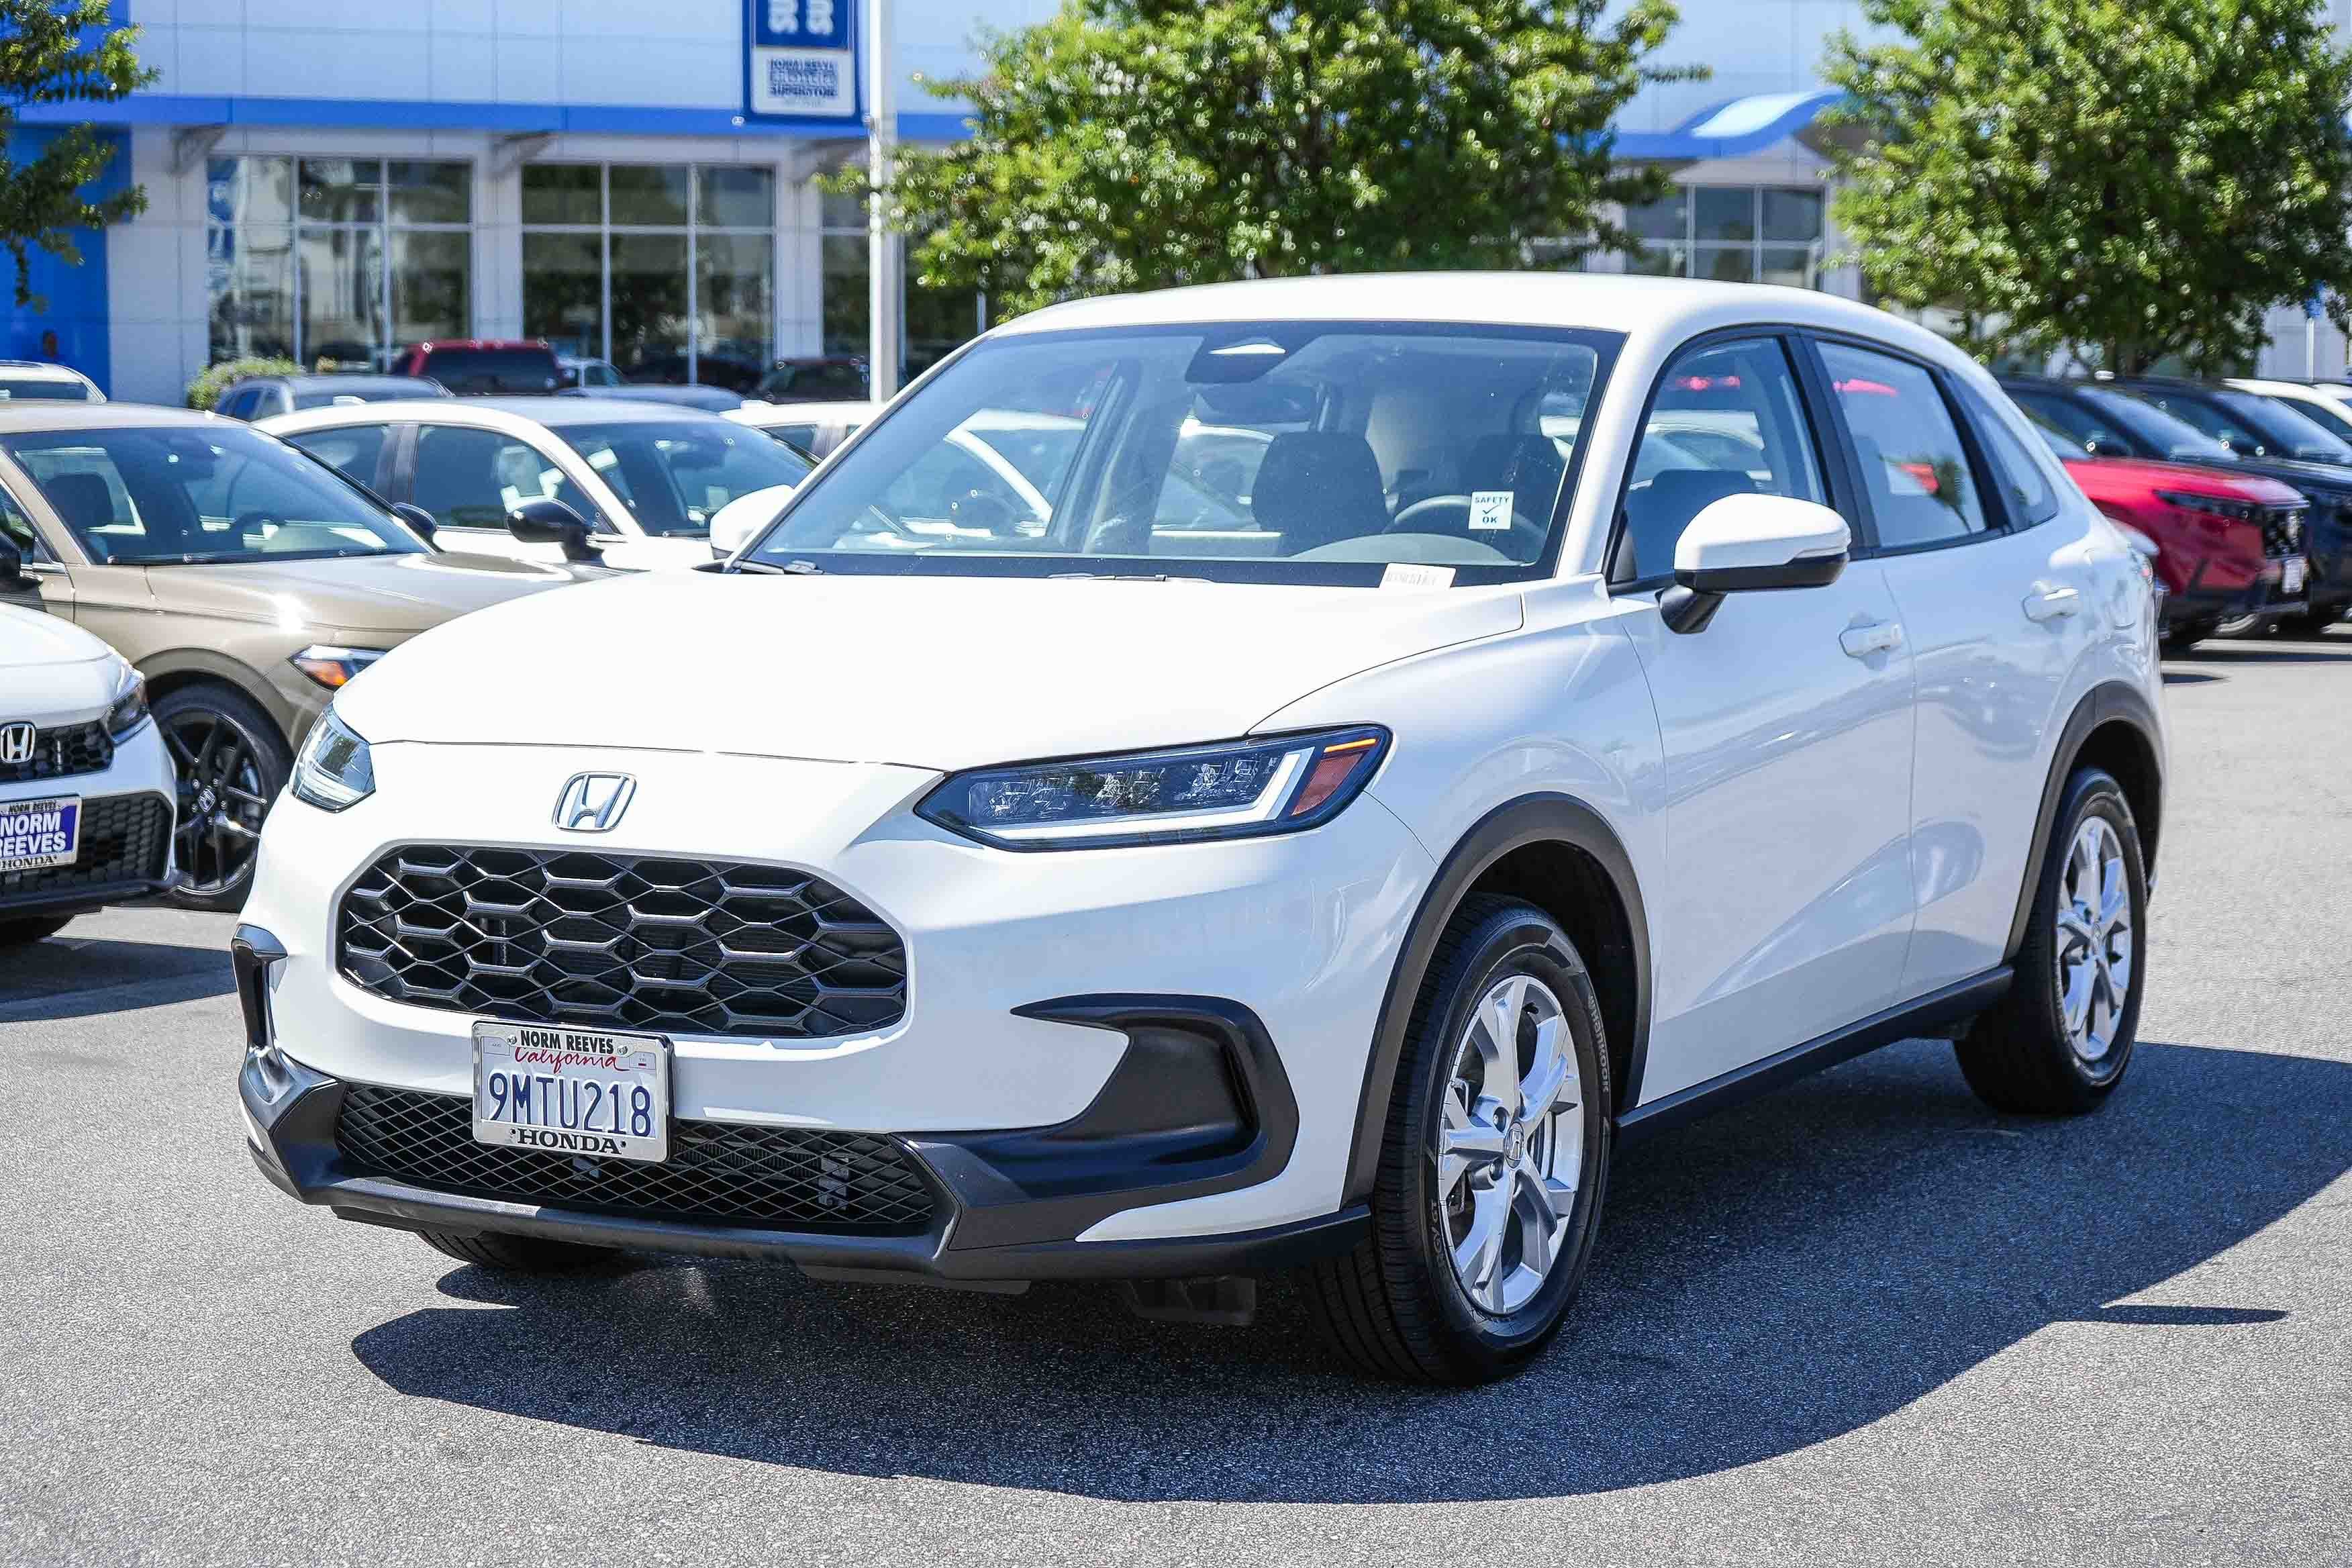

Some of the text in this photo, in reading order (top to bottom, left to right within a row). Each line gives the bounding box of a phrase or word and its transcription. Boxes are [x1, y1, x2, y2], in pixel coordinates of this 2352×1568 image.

[1475, 496, 1510, 504] SAFETY
[0, 812, 61, 837] NORM
[1, 856, 54, 868] HONDA
[520, 1030, 614, 1055] NORM REEVES
[515, 1046, 630, 1074] California
[489, 1072, 651, 1138] 9MTU218
[517, 1128, 622, 1155] HONDA
